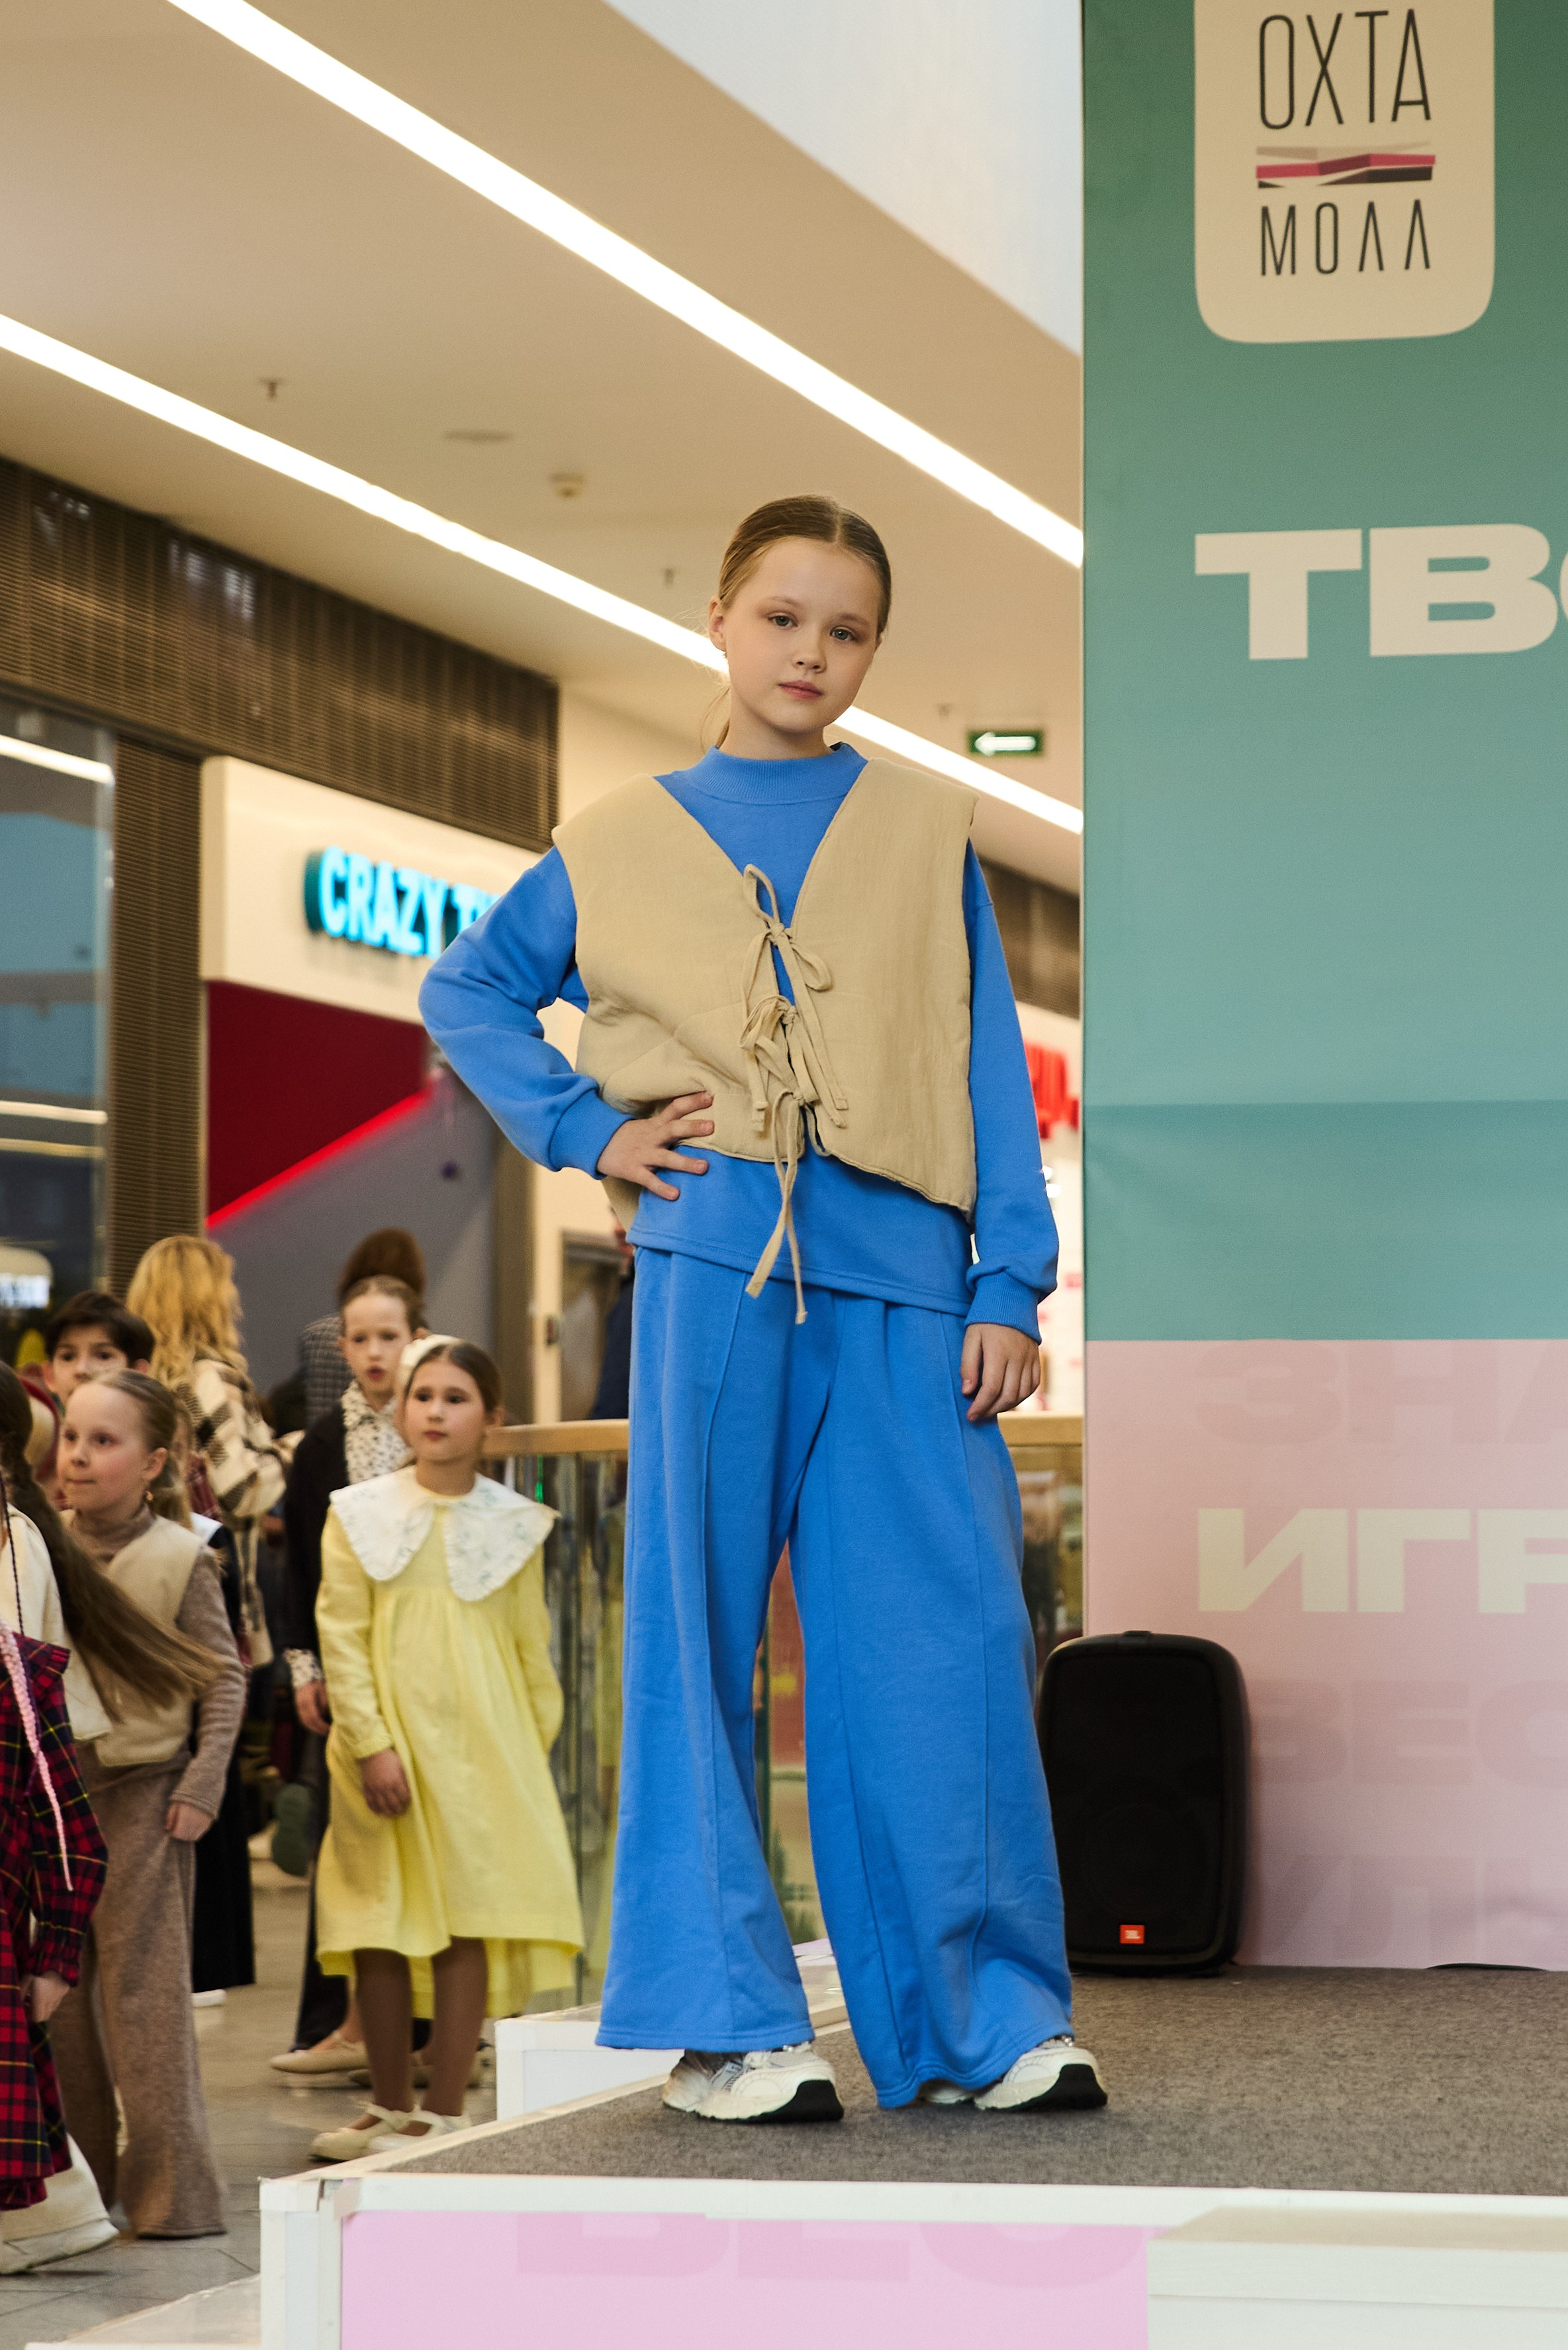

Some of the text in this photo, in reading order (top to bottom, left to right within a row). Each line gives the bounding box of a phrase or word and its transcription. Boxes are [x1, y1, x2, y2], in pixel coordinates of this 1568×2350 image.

[1258, 8, 1431, 130] ОХТА
[1261, 199, 1430, 277] МОЛЛ
[1195, 523, 1568, 661] ТВ
[319, 845, 448, 959] CRAZY
